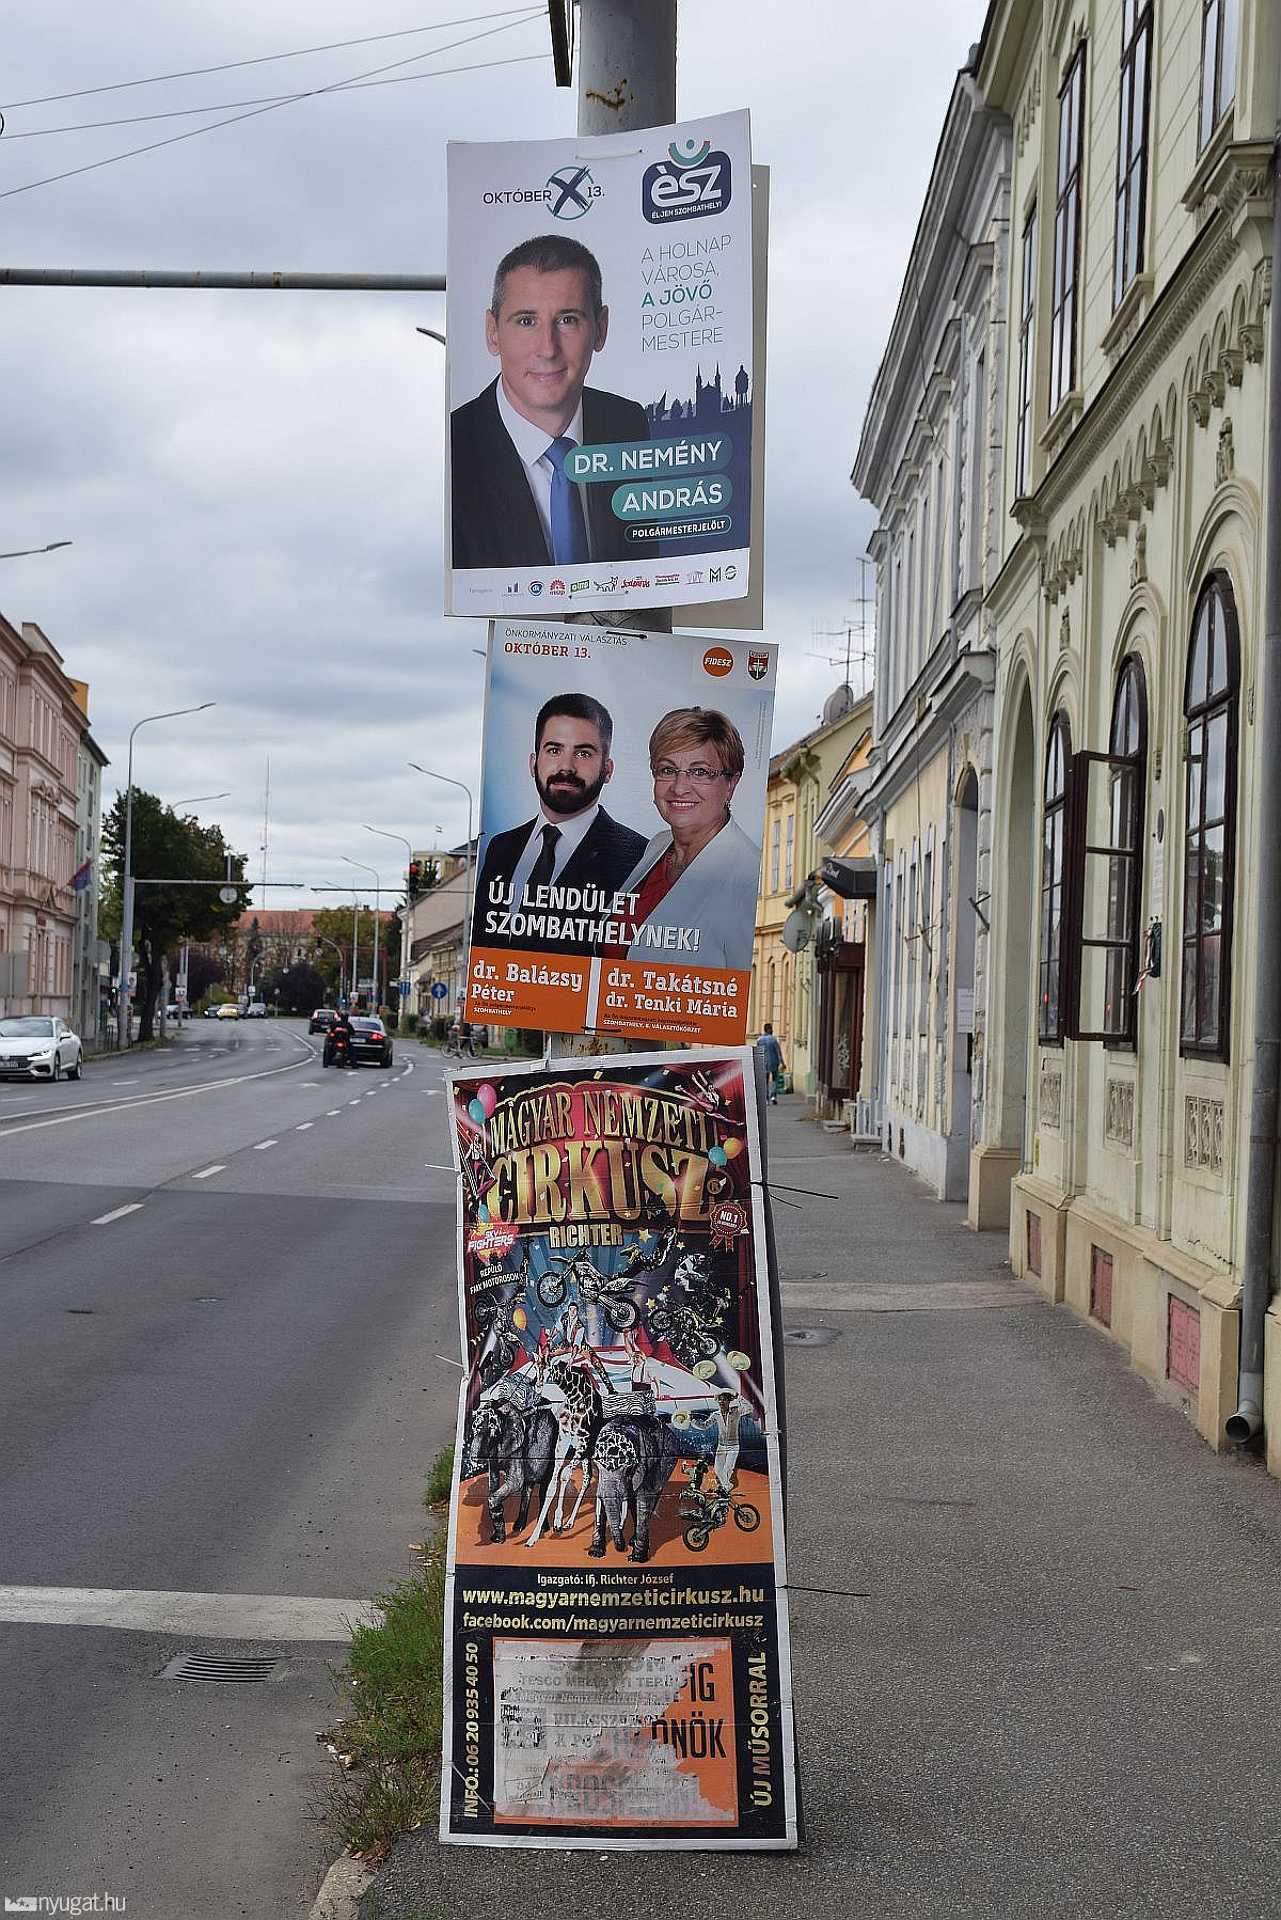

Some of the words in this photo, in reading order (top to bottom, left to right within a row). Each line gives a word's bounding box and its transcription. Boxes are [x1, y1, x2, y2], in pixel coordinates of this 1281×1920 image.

[483, 187, 552, 204] OKTÓBER
[587, 185, 605, 199] 13.
[641, 247, 653, 263] A
[660, 234, 732, 260] HOLNAP
[641, 260, 719, 286] VÁROSA,
[641, 293, 654, 308] A
[659, 283, 712, 306] JÖVŐ
[641, 308, 723, 331] POLGÁR-
[641, 327, 723, 353] MESTERE
[574, 453, 614, 474] DR.
[621, 439, 723, 471] NEMÉNY
[622, 482, 723, 512] ANDRÁS
[504, 641, 569, 657] OKTÓBER
[574, 647, 591, 658] 13.
[505, 628, 576, 641] ÖNKORMÁNYZATI
[580, 632, 628, 646] VÁLASZTÁS
[704, 657, 732, 667] FIDESZ
[488, 875, 515, 905] ÚJ
[522, 881, 640, 916] LENDÜLET
[485, 910, 701, 952] SZOMBATHELYNEK!
[473, 960, 499, 981] dr.
[506, 962, 583, 993] Balázsy
[607, 968, 635, 989] dr.
[643, 969, 739, 998] Takátsné
[470, 983, 515, 1003] Péter
[605, 991, 628, 1009] dr.
[634, 993, 683, 1014] Tenki
[686, 995, 738, 1019] Mária
[489, 1091, 576, 1158] MAGYAR
[583, 1090, 709, 1153] NEMZETI
[486, 1140, 713, 1226] CIRKUSZ
[719, 1210, 739, 1224] NO.1
[468, 1234, 513, 1250] FIGHTERS
[549, 1223, 624, 1248] RICHTER
[537, 1573, 584, 1587] Igazgató:
[600, 1573, 638, 1585] Richter
[640, 1572, 675, 1584] József
[463, 1586, 765, 1609] www.magyarnemzeticirkusz.hu
[463, 1612, 764, 1633] facebook.com/magyarnemzeticirkusz
[465, 1642, 479, 1664] 50
[748, 1651, 771, 1776] MŰSORRAL
[750, 1779, 773, 1807] ÚJ
